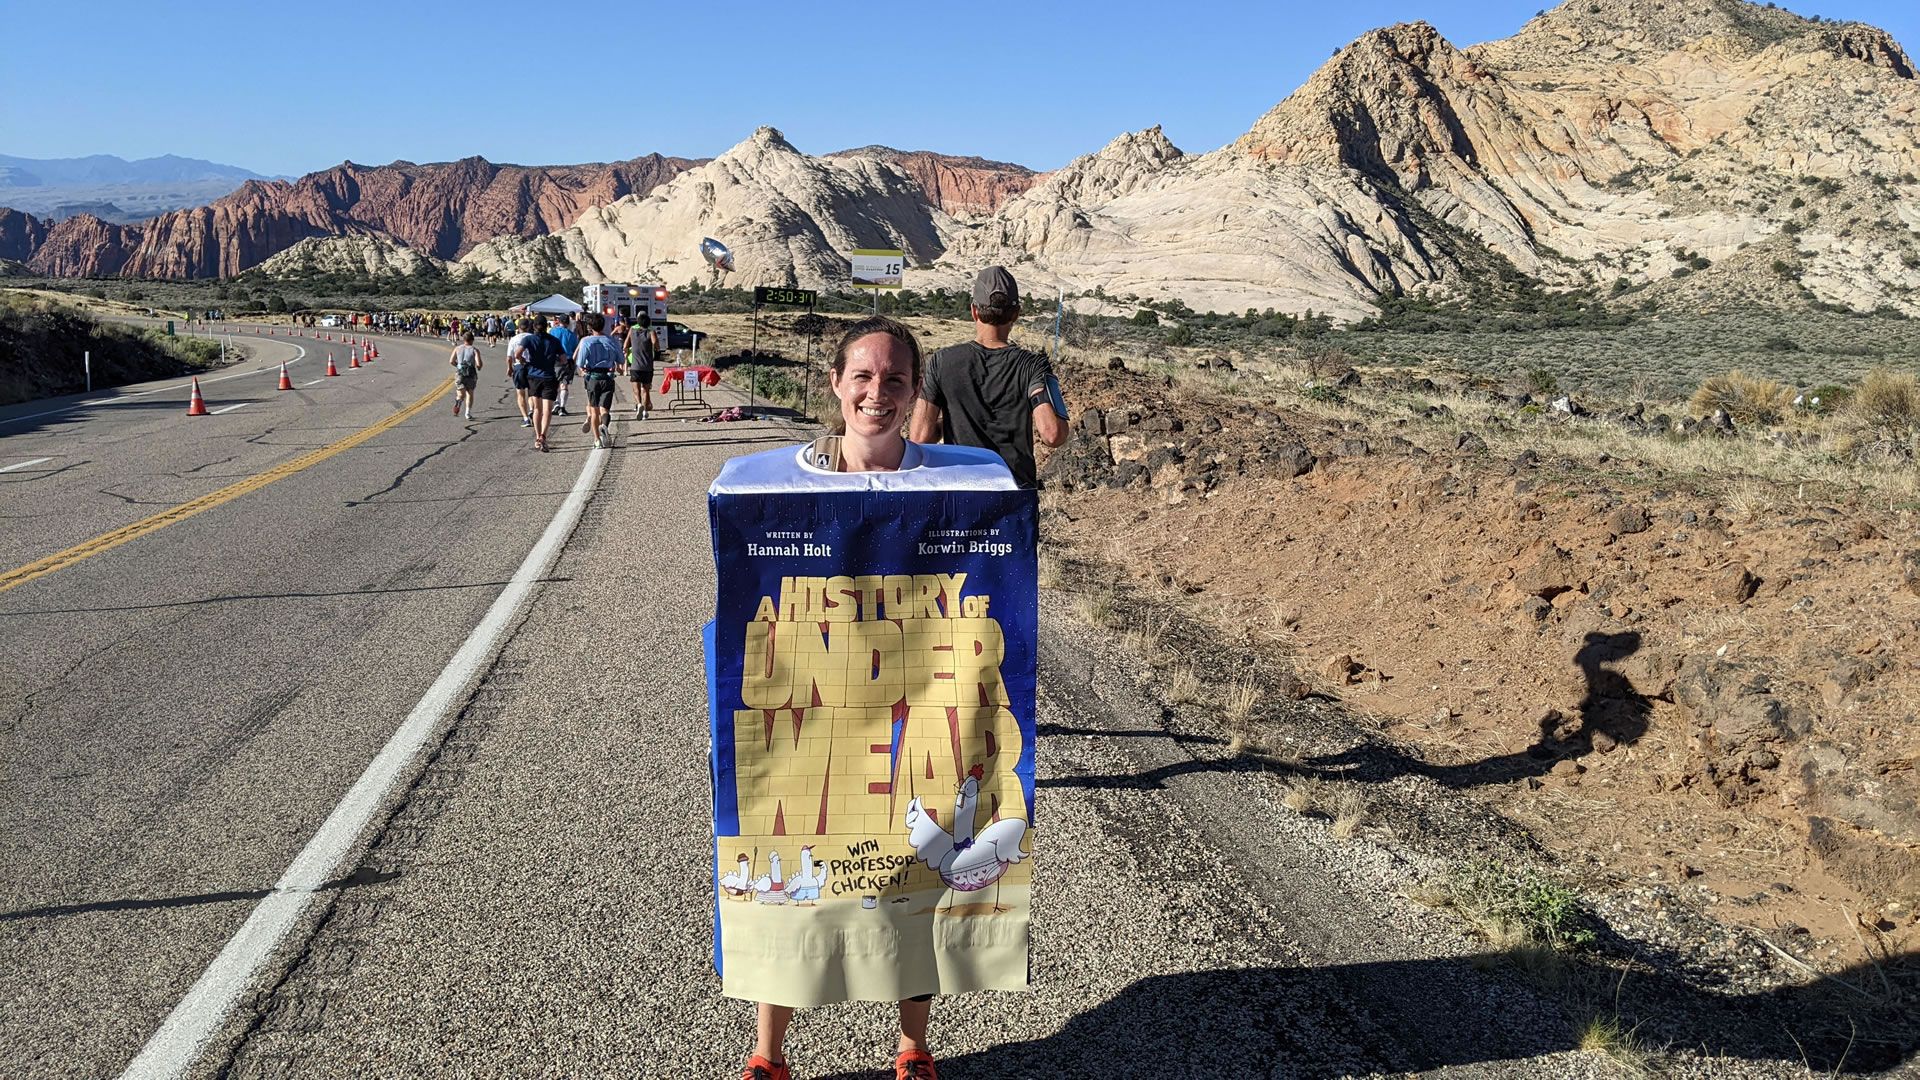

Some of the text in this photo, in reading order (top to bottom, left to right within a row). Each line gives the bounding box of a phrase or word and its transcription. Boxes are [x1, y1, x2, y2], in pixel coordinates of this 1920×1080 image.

[885, 263, 901, 275] 15
[765, 531, 814, 539] WRITTEN BY
[928, 528, 1000, 538] ILLUSTRATIONS BY
[747, 543, 832, 557] Hannah Holt
[918, 540, 1013, 557] Korwin Briggs
[753, 573, 990, 622] A HISTORY OF
[741, 617, 1011, 710] UNDER
[733, 705, 1028, 836] WEAR
[847, 839, 880, 858] WITH
[830, 854, 917, 877] PROFESSOR
[831, 870, 909, 897] CHICKEN!
